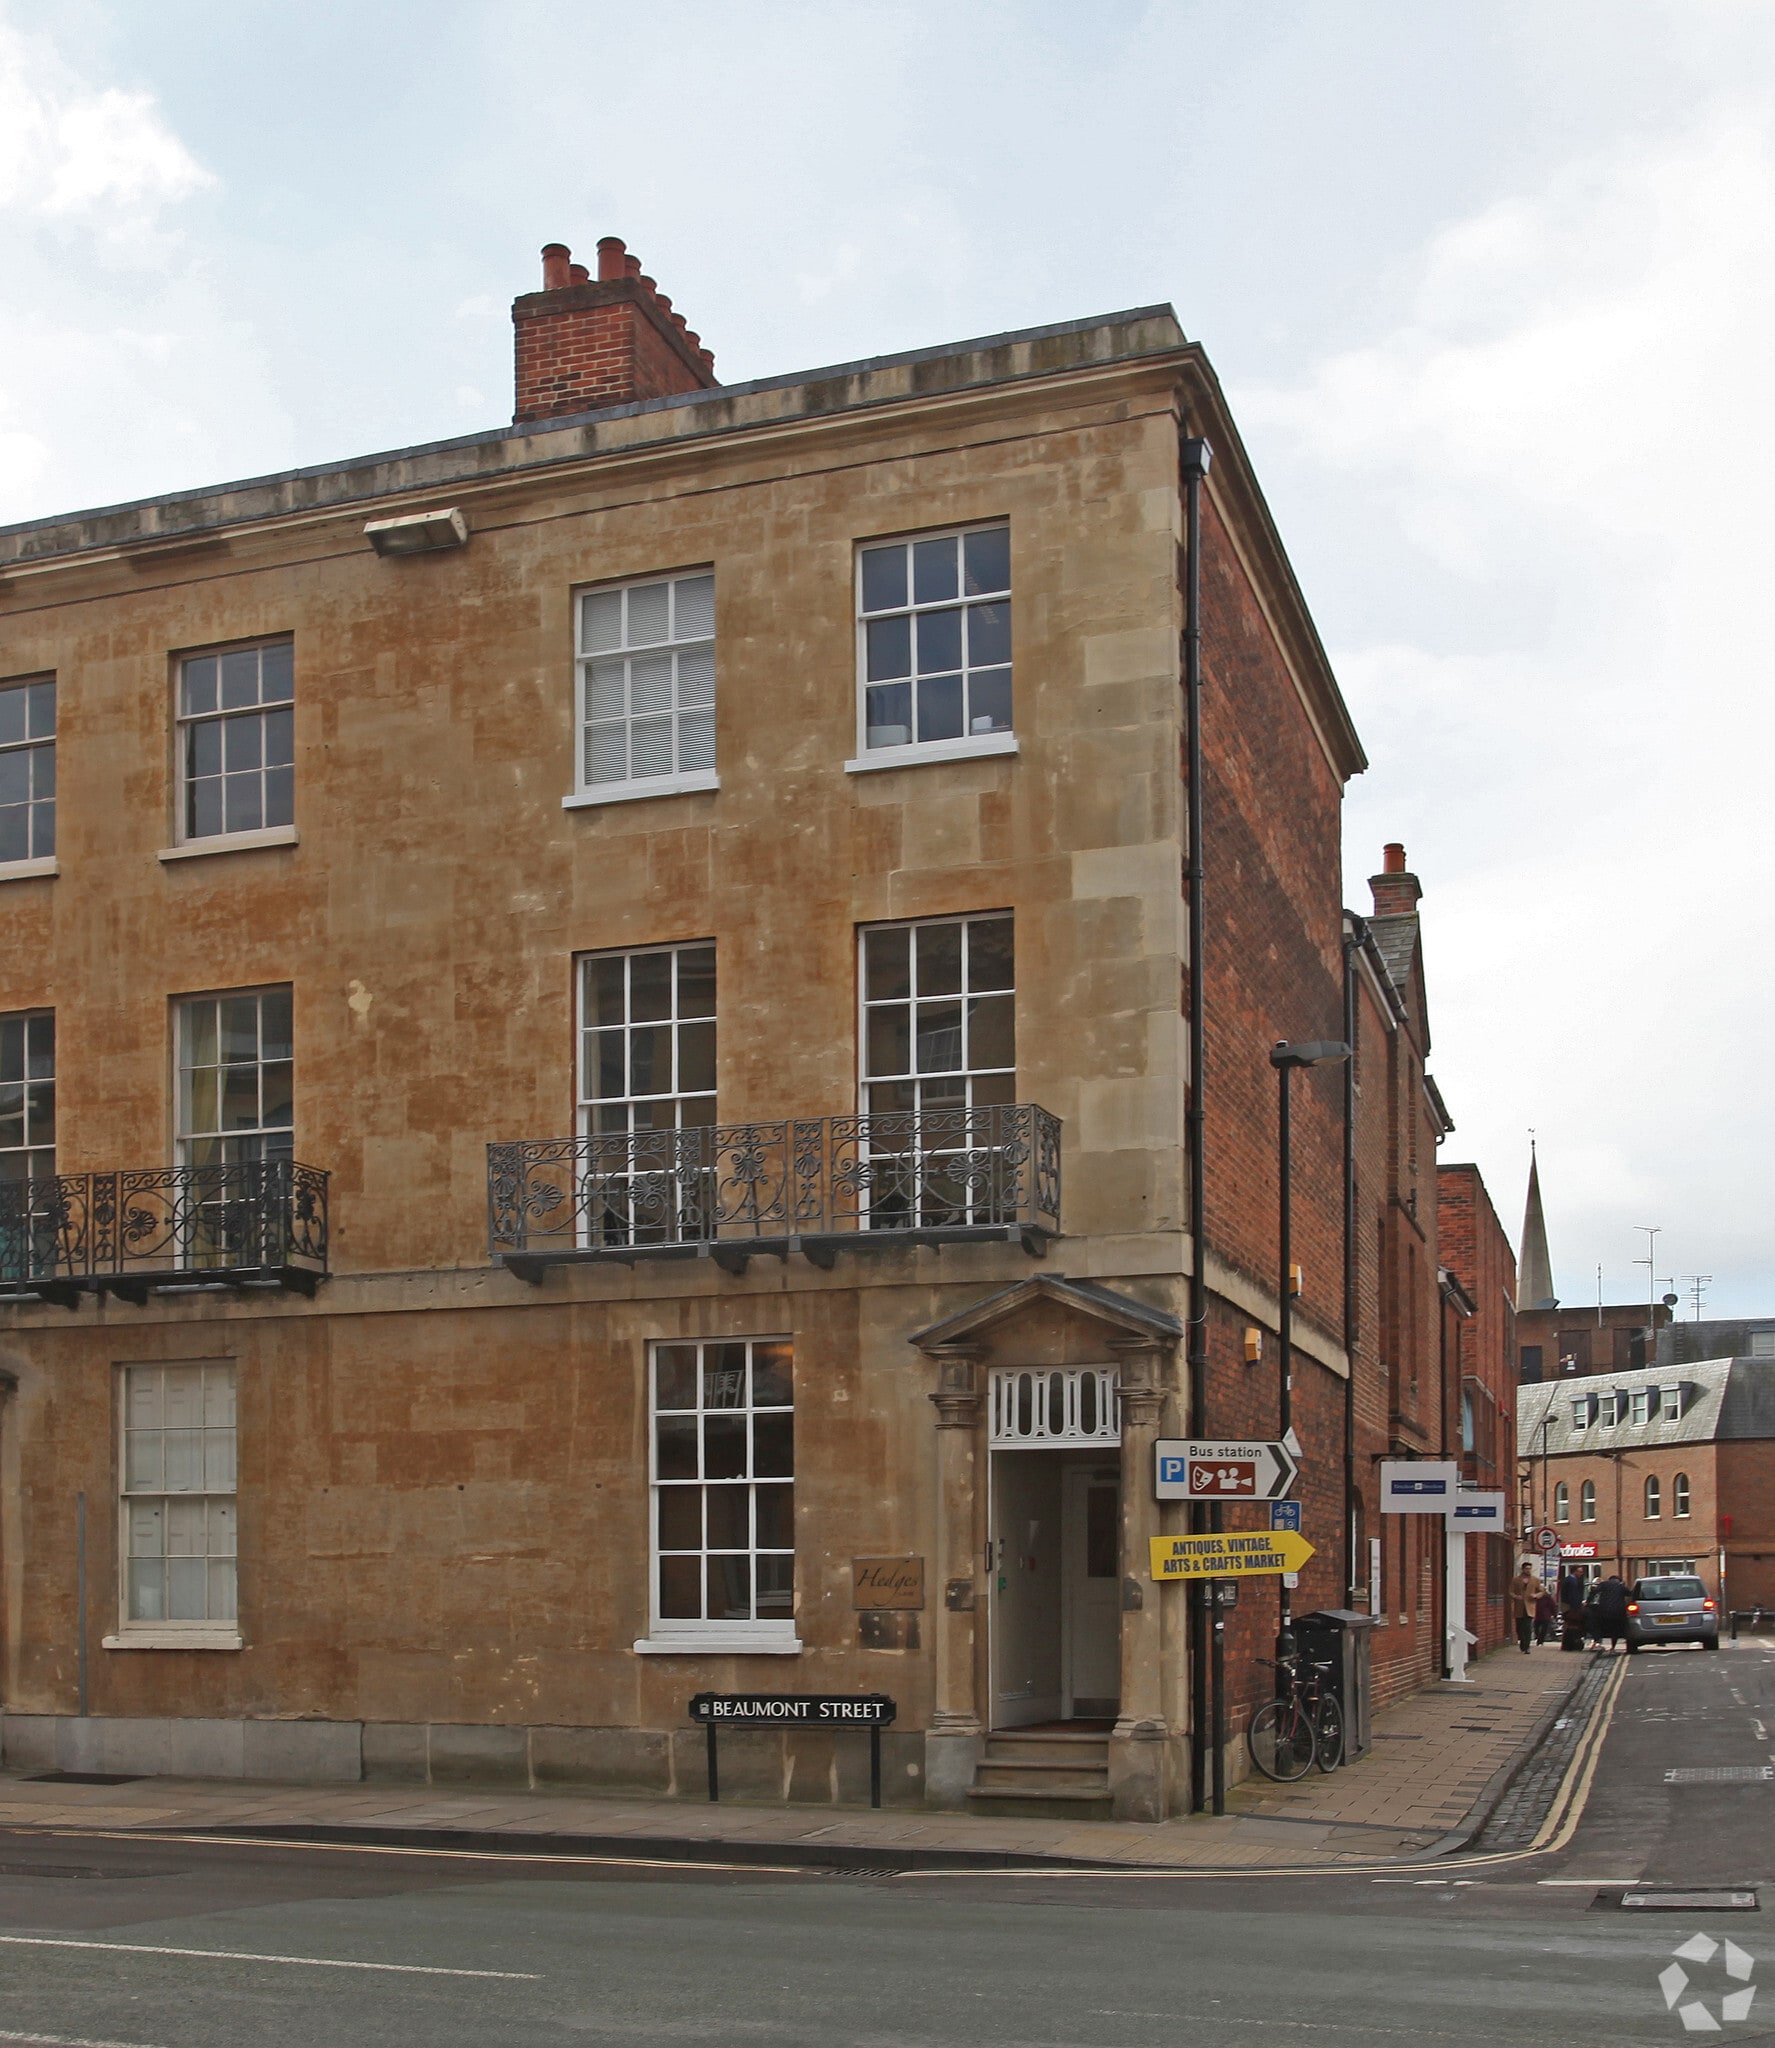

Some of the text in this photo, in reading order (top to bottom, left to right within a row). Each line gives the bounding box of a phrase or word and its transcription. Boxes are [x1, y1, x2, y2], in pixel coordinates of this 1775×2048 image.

[1189, 1446, 1262, 1458] Bus station
[1166, 1460, 1181, 1480] P
[1286, 1520, 1295, 1530] 9
[1172, 1537, 1273, 1556] ANTIQUES, VINTAGE,
[1163, 1553, 1286, 1573] ARTS & CRAFTS MARKET
[712, 1701, 884, 1719] BEAUMONT STREET
